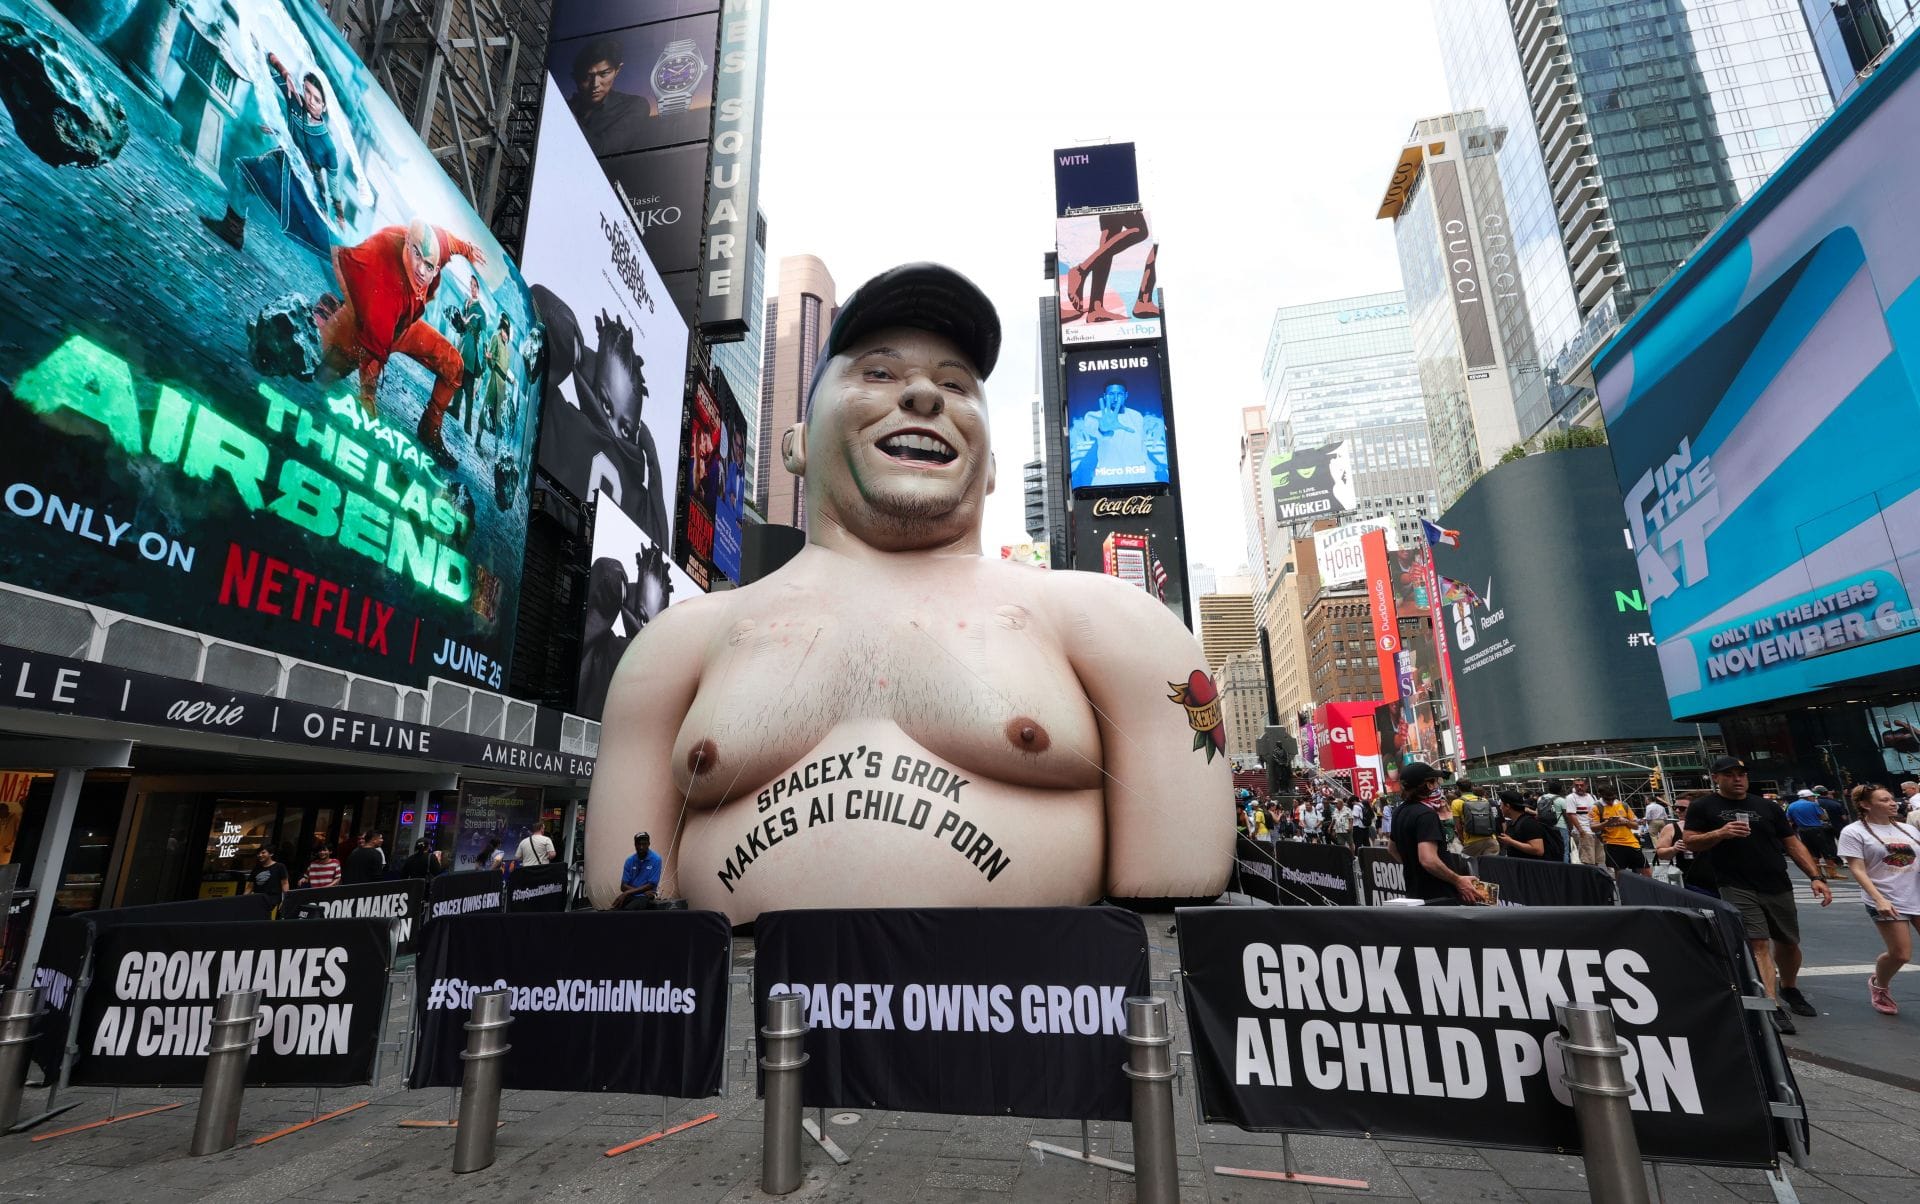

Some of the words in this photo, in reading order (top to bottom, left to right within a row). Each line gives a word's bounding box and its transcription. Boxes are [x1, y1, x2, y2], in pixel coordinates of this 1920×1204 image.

[1059, 154, 1089, 166] WITH
[1383, 162, 1412, 206] voco
[629, 195, 660, 206] lassic
[634, 206, 682, 228] IKO
[708, 98, 744, 297] SQUARE
[1445, 219, 1478, 304] GUCCI
[1078, 356, 1149, 372] SAMSUNG
[258, 382, 368, 482] THE
[373, 459, 472, 545] LAST
[327, 393, 448, 489] AVATAR
[1654, 434, 1692, 497] IN
[1095, 465, 1124, 477] Micro
[1125, 464, 1147, 475] RGB
[1646, 455, 1716, 531] THE
[4, 482, 133, 548] ONLY
[138, 530, 196, 572] ON
[1092, 495, 1155, 517] Coca-Cola
[1323, 526, 1359, 549] LITTLE
[219, 541, 395, 656] NETFLIX
[433, 638, 488, 682] JUNE
[486, 664, 502, 690] 25
[1375, 579, 1390, 631] DuckDuckGo
[1711, 623, 1751, 648] ONLY
[1754, 615, 1775, 636] IN
[1777, 580, 1878, 628] THEATERS
[1707, 612, 1868, 679] NOVEMBER
[1874, 601, 1899, 631] 6
[0, 661, 82, 705] LE
[166, 697, 245, 727] aerie
[303, 712, 431, 753] OFFLINE
[481, 743, 563, 773] AMERICAN
[569, 758, 596, 776] EAG
[467, 793, 489, 808] Target
[757, 745, 883, 814] SPACEX'S
[891, 754, 970, 804] GROK
[1357, 770, 1373, 801] tkts
[216, 834, 243, 848] your
[223, 821, 242, 834] live
[403, 812, 438, 823] ON
[464, 818, 498, 831] Streaming
[717, 806, 799, 894] MAKES
[808, 792, 834, 828] AI
[845, 789, 932, 831] CHILD
[933, 809, 1011, 883] PORN
[1372, 861, 1407, 892] GROK
[308, 898, 356, 920] ROK
[355, 892, 409, 918] MAKES
[431, 898, 462, 919] SPACEX
[461, 894, 482, 914] OWNS
[480, 891, 501, 909] GROK
[115, 950, 217, 1000] GROK
[216, 947, 350, 1000] MAKES
[1242, 942, 1404, 1016] GROK
[92, 1005, 136, 1057] AI
[136, 1005, 214, 1057] CHIL
[250, 1003, 354, 1056] PORN
[769, 983, 895, 1030] PACEX
[903, 983, 1015, 1033] OWNS
[1020, 984, 1127, 1037] GROK
[1235, 1016, 1294, 1088] AI
[1299, 1019, 1489, 1101] CHILD
